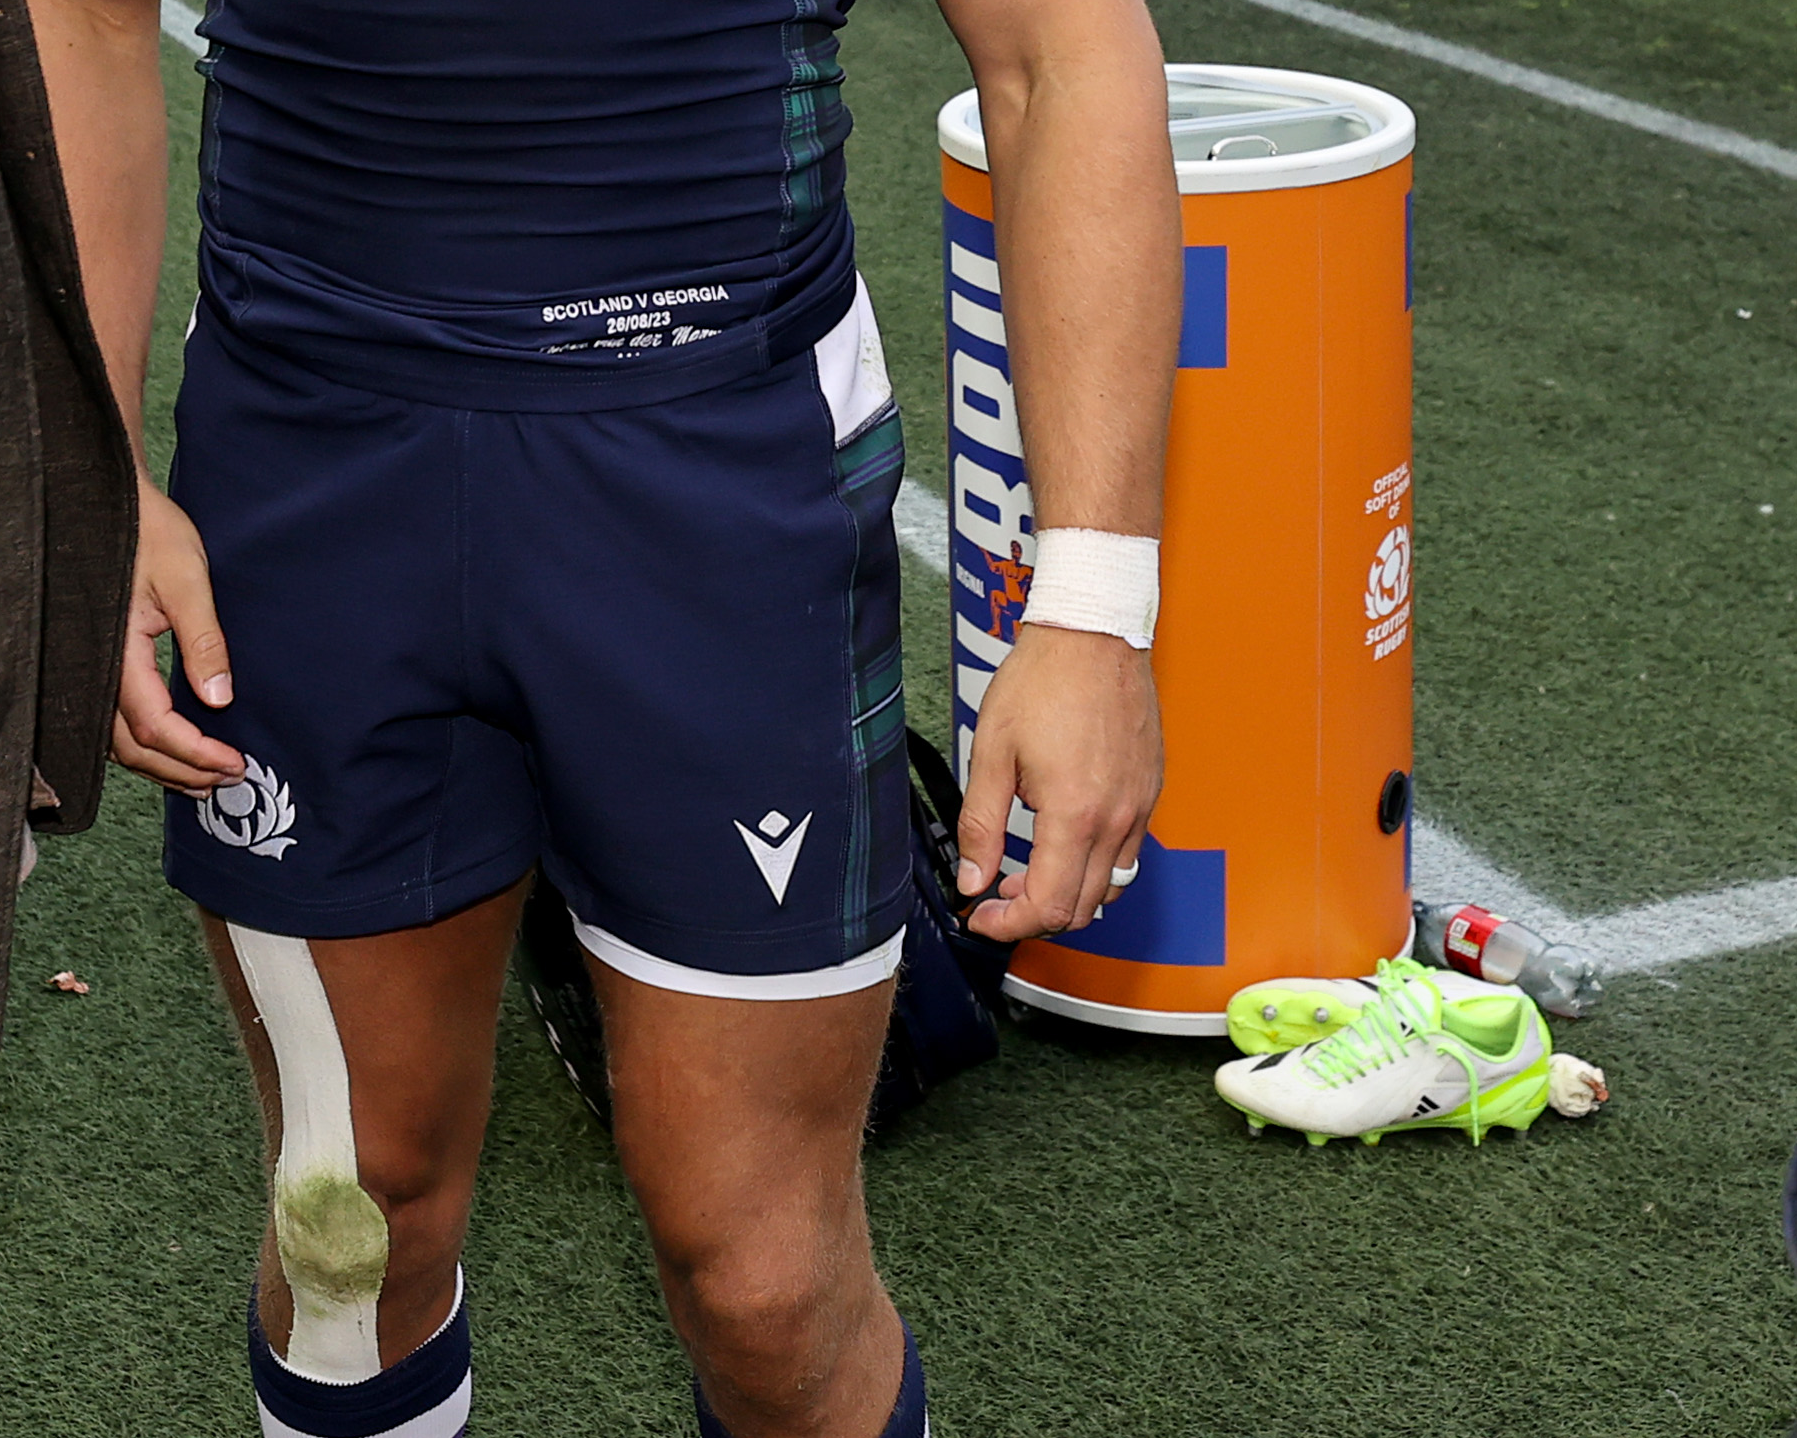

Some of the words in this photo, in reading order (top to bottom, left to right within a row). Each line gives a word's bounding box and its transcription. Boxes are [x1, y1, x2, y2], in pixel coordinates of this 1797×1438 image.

[542, 295, 633, 323] SCOTLAND
[634, 293, 648, 309] V
[651, 285, 730, 307] GEORGIA
[606, 311, 672, 335] 26/08/23
[1373, 461, 1409, 494] OFFICIAL
[1364, 490, 1393, 515] SOFT
[1387, 500, 1401, 520] OF
[1373, 623, 1408, 662] RUGBY
